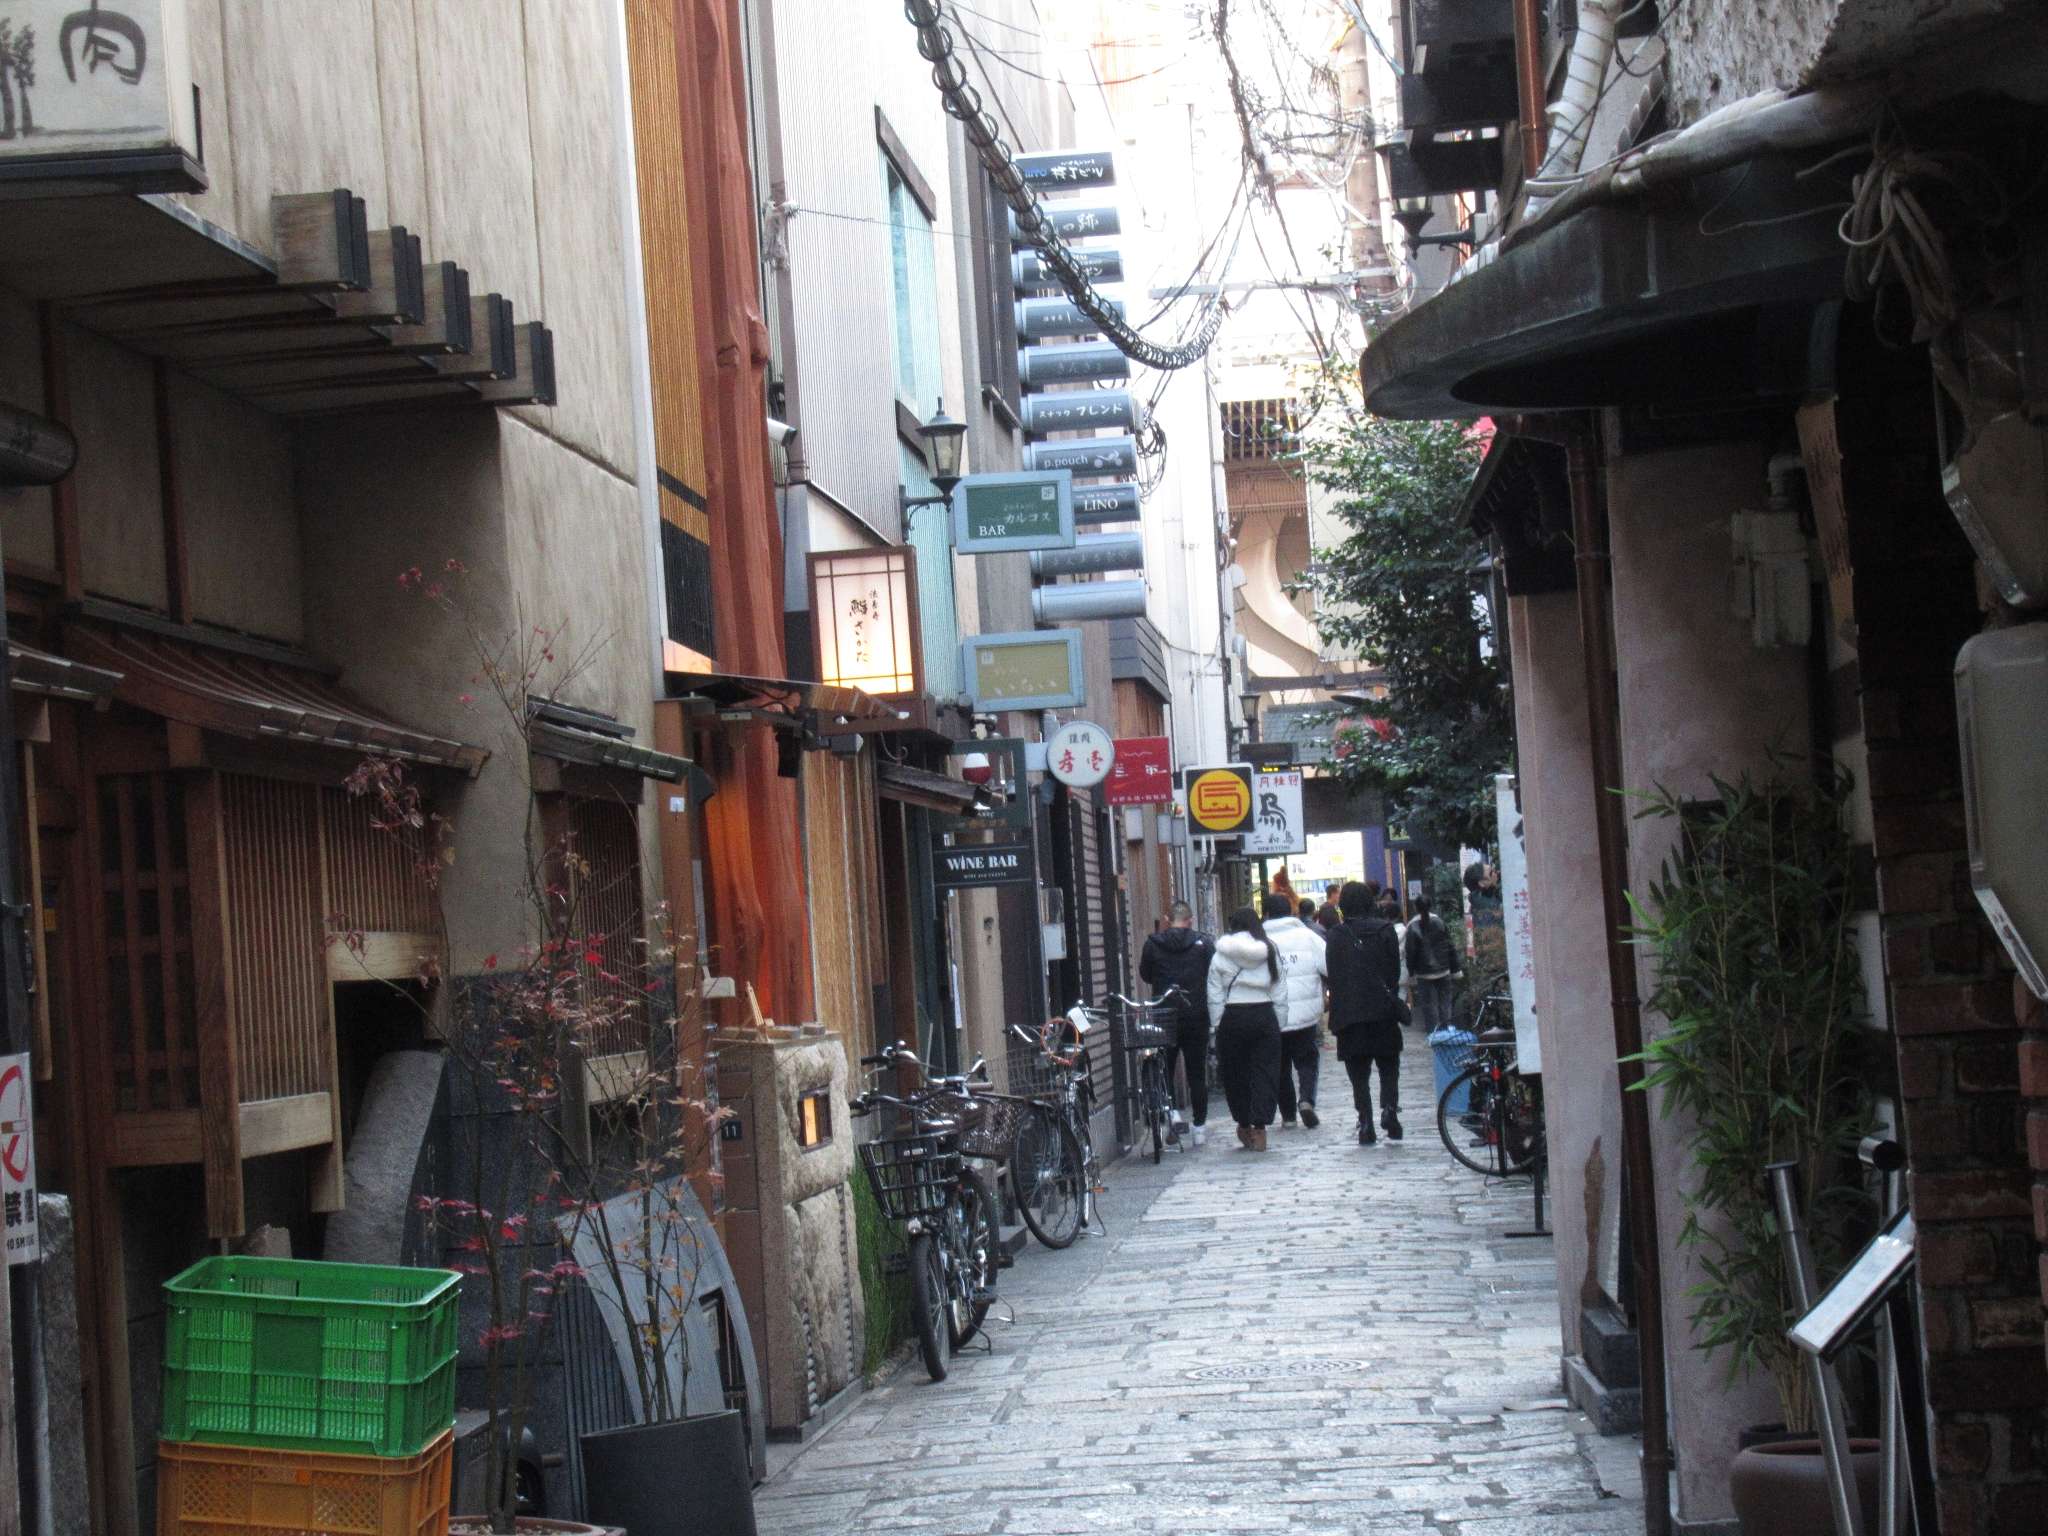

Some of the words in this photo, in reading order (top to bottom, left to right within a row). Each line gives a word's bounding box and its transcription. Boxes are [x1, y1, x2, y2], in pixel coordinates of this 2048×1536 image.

[1077, 403, 1123, 416] フレンド
[1044, 456, 1088, 468] p.pouch
[1084, 498, 1118, 511] LINO
[979, 525, 1006, 536] BAR
[988, 855, 1018, 868] BAR
